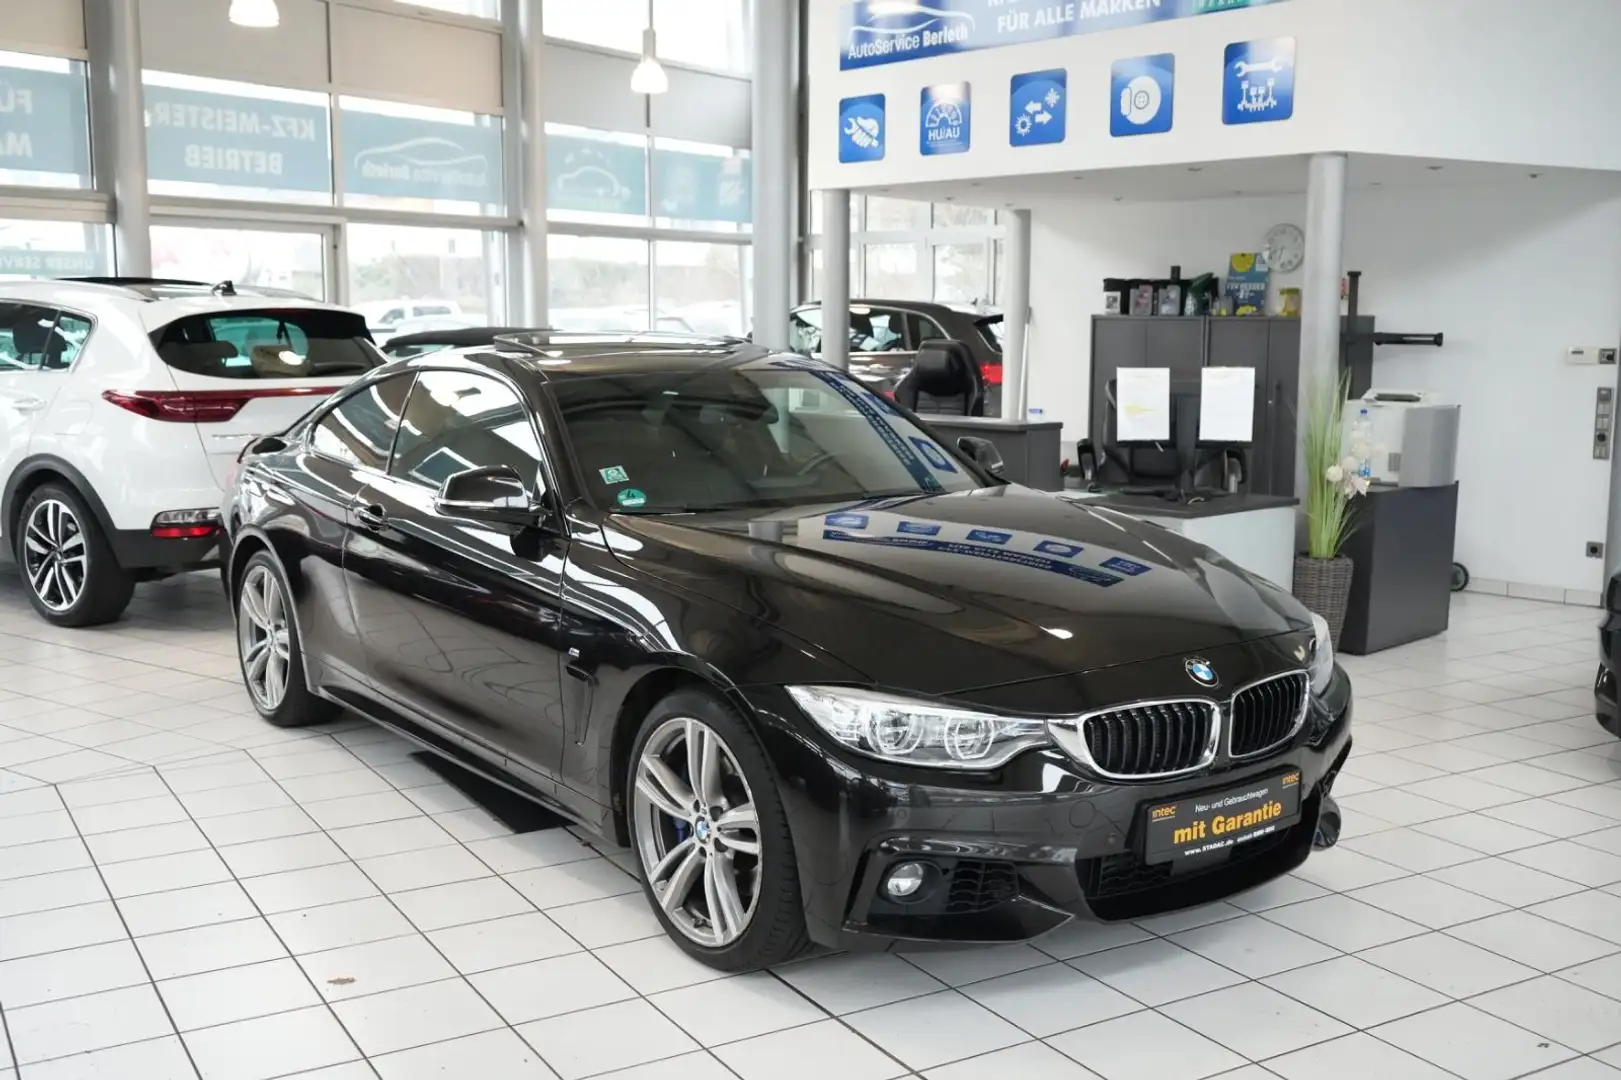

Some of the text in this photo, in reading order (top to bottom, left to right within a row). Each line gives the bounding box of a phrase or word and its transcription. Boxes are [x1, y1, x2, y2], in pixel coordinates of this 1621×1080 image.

[997, 14, 1030, 34] FÜR
[1034, 4, 1075, 28] ALLE
[848, 23, 969, 60] AutoService Berleth
[1174, 820, 1207, 845] mit
[1211, 800, 1282, 836] Garantie
[1195, 803, 1211, 813] Neu-
[1211, 799, 1223, 809] und
